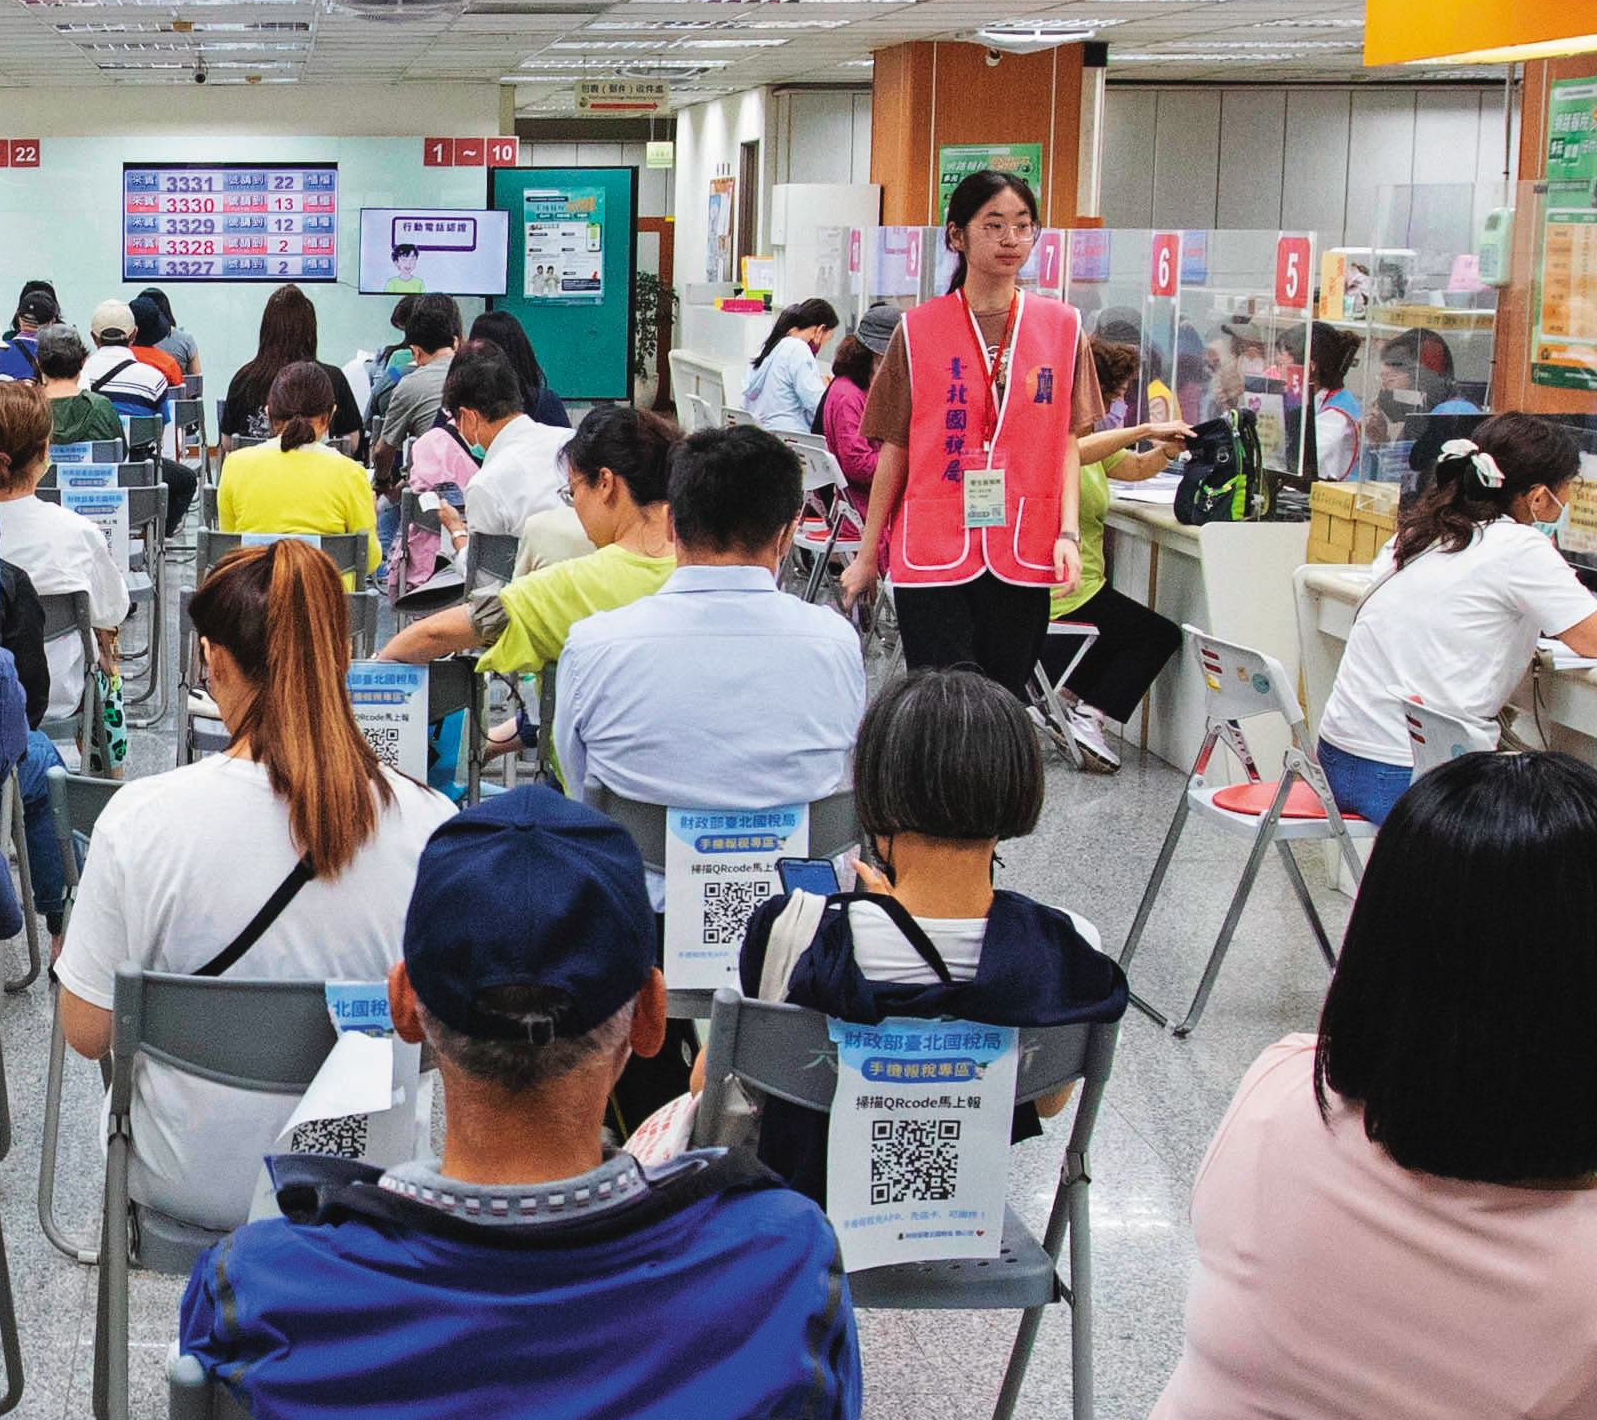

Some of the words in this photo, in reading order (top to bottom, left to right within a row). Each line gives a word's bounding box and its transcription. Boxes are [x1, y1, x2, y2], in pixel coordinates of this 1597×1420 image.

[15, 147, 36, 162] 22
[433, 143, 442, 162] 1
[492, 144, 512, 161] 10
[166, 177, 214, 192] 3331
[274, 177, 294, 189] 22
[166, 198, 214, 213] 3330
[274, 198, 294, 210] 13
[166, 219, 214, 234] 3329
[274, 219, 294, 231] 12
[166, 240, 214, 255] 3328
[279, 240, 288, 252] 2
[1044, 245, 1054, 271] 7
[1158, 247, 1169, 281] 6
[166, 261, 214, 275] 3327
[279, 261, 288, 274] 2
[1285, 254, 1299, 298] 5
[679, 812, 797, 831] 財政部臺北國稅局
[844, 1031, 1001, 1051] 財政部臺北國稅局
[856, 1096, 982, 1110] 掃描QRcode馬上報
